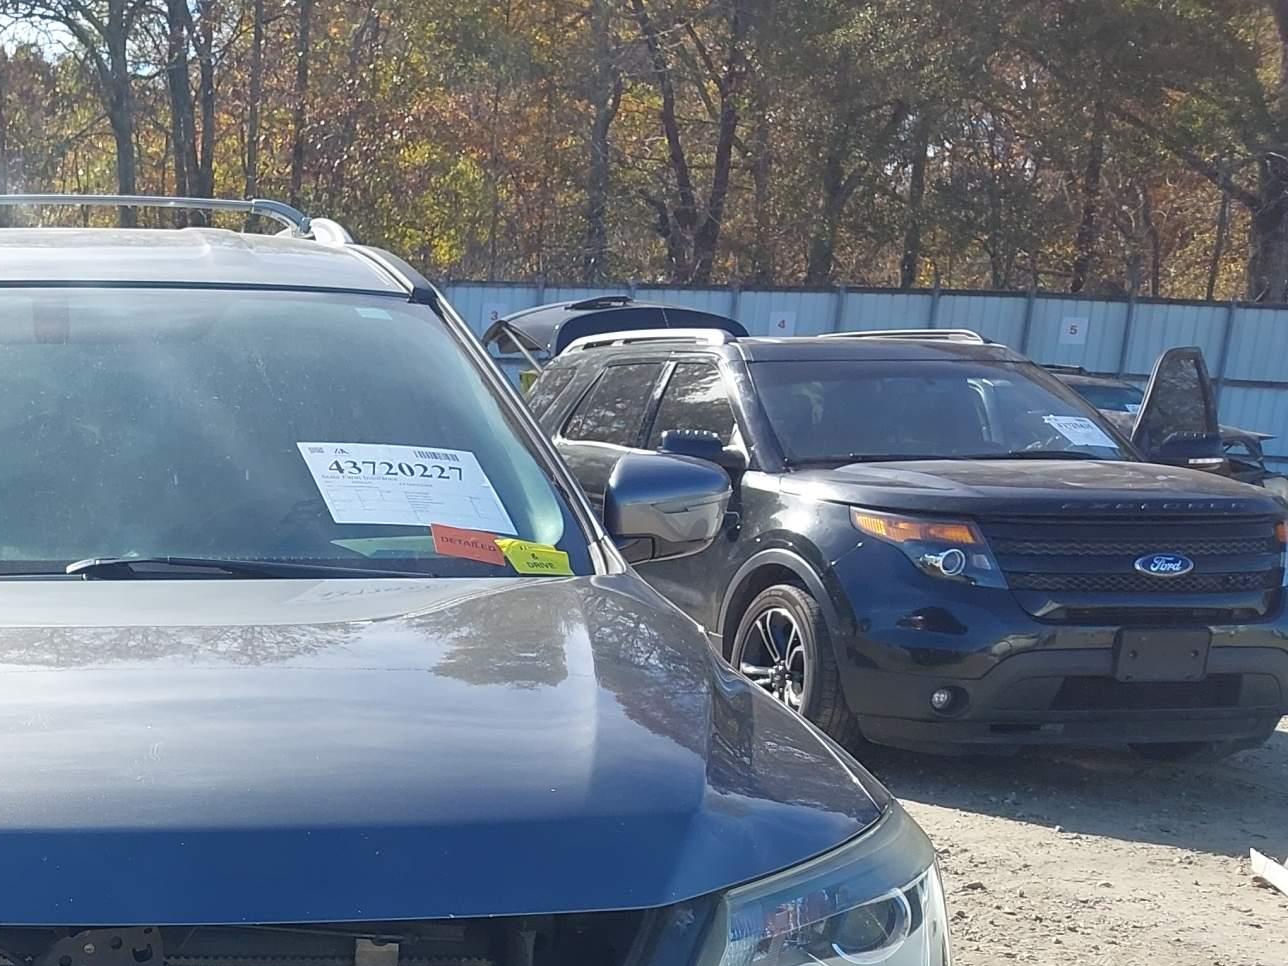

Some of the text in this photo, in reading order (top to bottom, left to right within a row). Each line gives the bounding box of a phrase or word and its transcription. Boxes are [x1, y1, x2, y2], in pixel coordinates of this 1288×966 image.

[777, 319, 786, 329] 4
[1069, 324, 1078, 335] 5
[328, 459, 463, 481] 43720227
[440, 536, 497, 552] DETAILED
[526, 561, 556, 570] DRIVE
[1150, 556, 1182, 572] Ford
